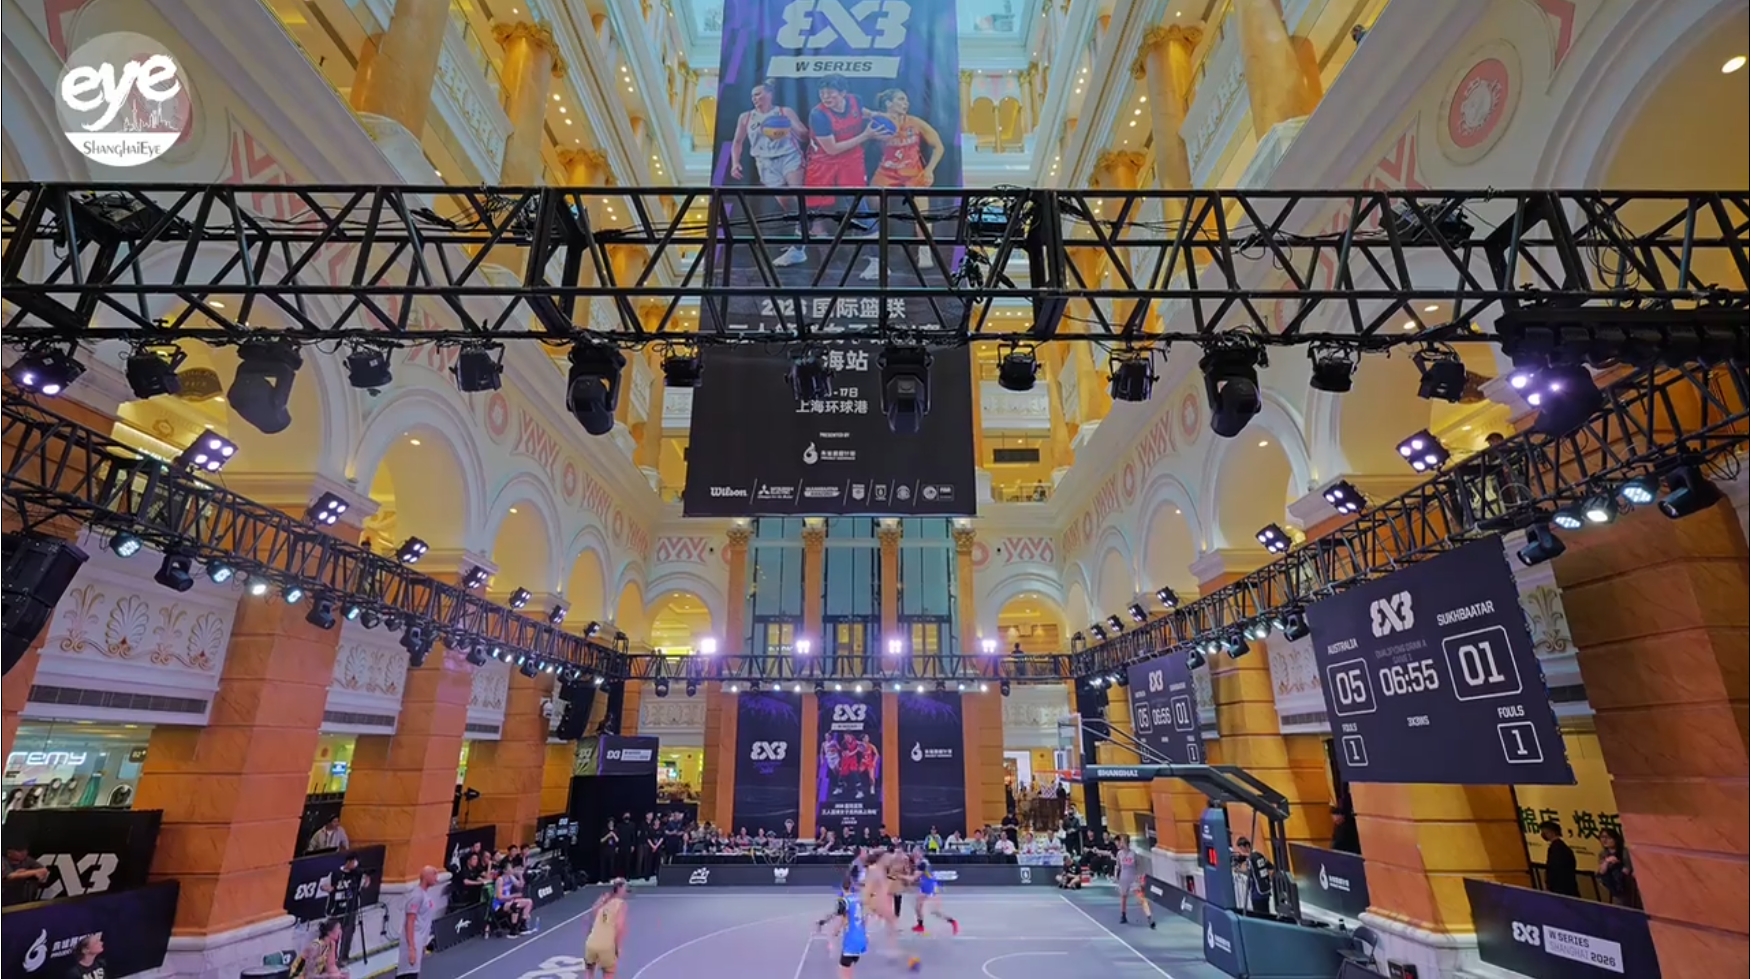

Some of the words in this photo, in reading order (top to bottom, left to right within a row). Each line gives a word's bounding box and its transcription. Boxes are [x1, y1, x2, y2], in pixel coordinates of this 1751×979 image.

[796, 61, 808, 72] W
[812, 60, 872, 72] SERIES
[821, 350, 868, 371] 海站
[795, 400, 869, 414] 上海环球港
[710, 486, 748, 497] Wilson
[1437, 600, 1495, 626] SUKHBAATAR
[1327, 638, 1359, 655] AUSTRALIA
[1458, 641, 1505, 686] 01
[1335, 669, 1367, 705] 05
[1379, 658, 1440, 697] 06:55
[1176, 702, 1189, 724] 01
[1497, 705, 1525, 719] FOULS
[1350, 741, 1360, 760] 1
[1511, 729, 1528, 756] 1
[6, 751, 87, 766] remy
[1097, 769, 1138, 777] SHANGHAI
[1548, 930, 1557, 940] W
[1558, 933, 1589, 948] SERIES
[1549, 941, 1589, 960] SHANGHAI
[1591, 952, 1616, 967] 2026
